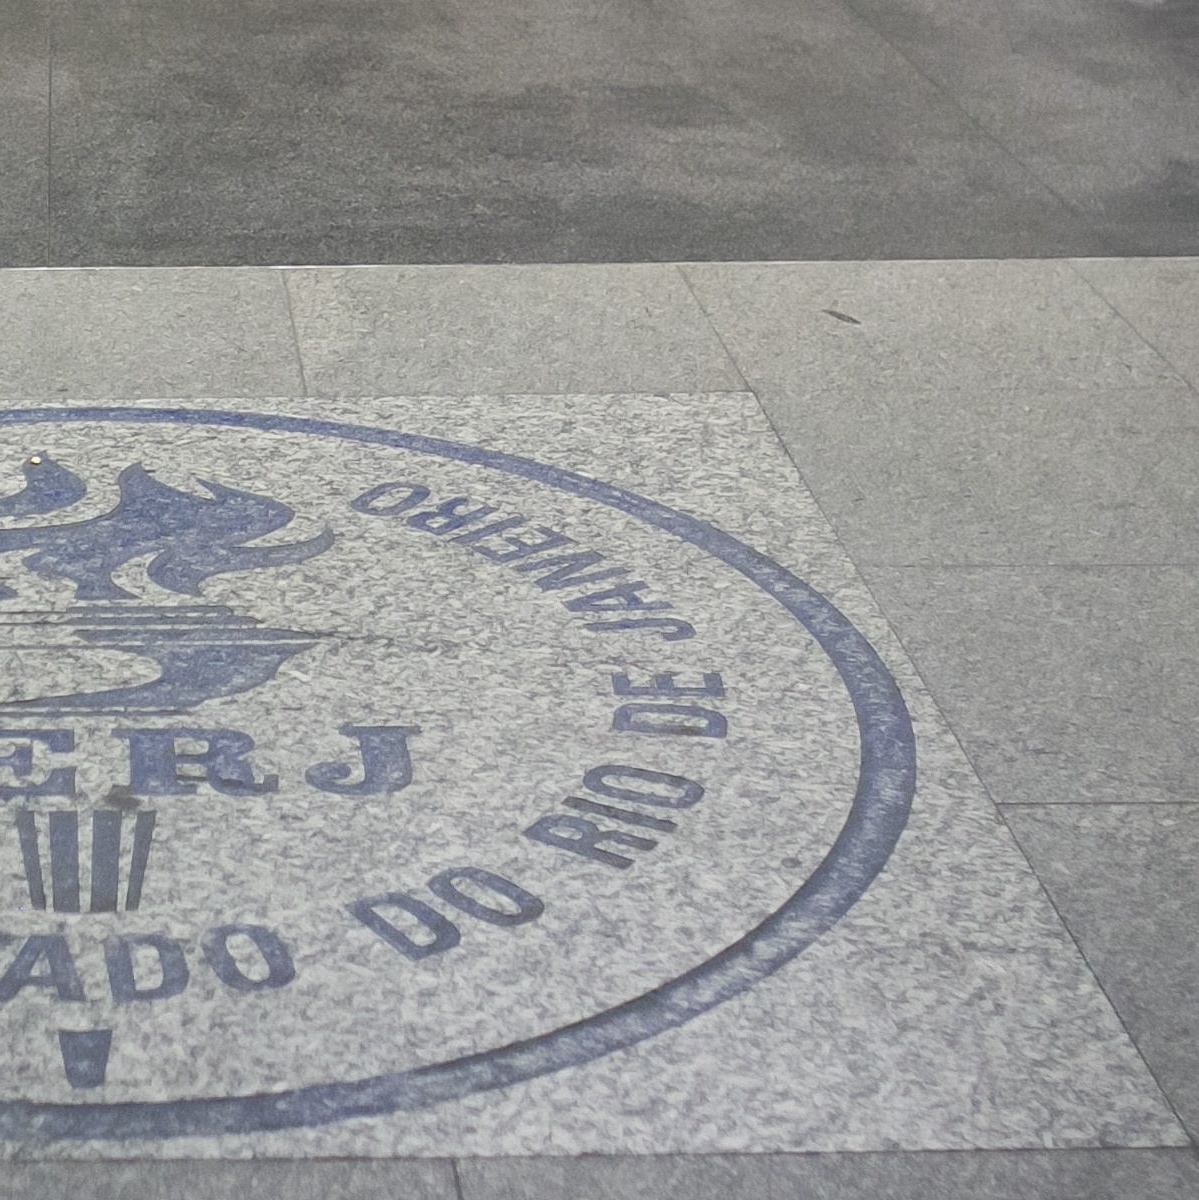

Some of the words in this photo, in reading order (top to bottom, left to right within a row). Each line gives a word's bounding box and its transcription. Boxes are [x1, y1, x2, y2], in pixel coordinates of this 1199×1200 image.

[353, 483, 697, 641] JANEIRO
[611, 672, 727, 738] DE
[523, 764, 706, 868] RIO
[351, 867, 545, 960] DO
